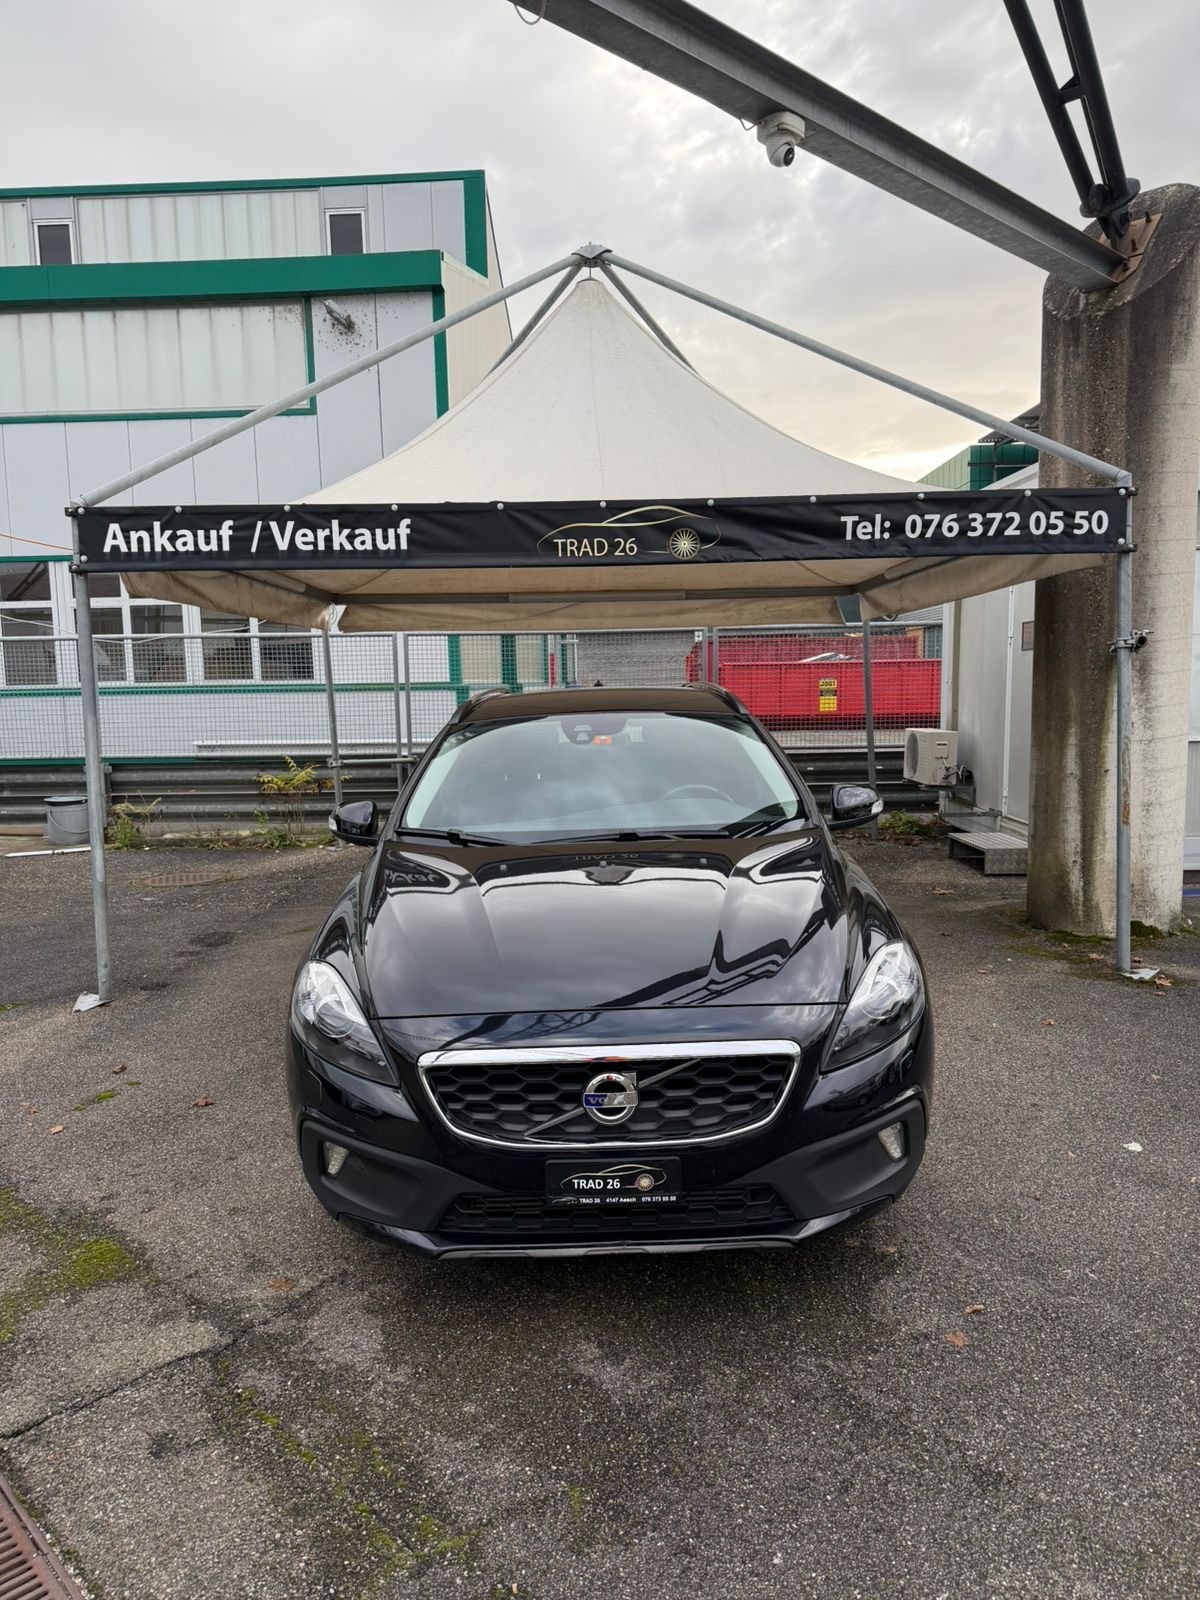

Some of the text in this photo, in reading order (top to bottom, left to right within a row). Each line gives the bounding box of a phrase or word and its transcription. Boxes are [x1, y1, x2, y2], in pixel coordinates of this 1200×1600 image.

[103, 520, 234, 553] Ankauf
[840, 509, 1109, 541] Tel: 076 372 05 50
[553, 537, 638, 557] TRAD 26
[572, 1178, 621, 1189] TRAD 26
